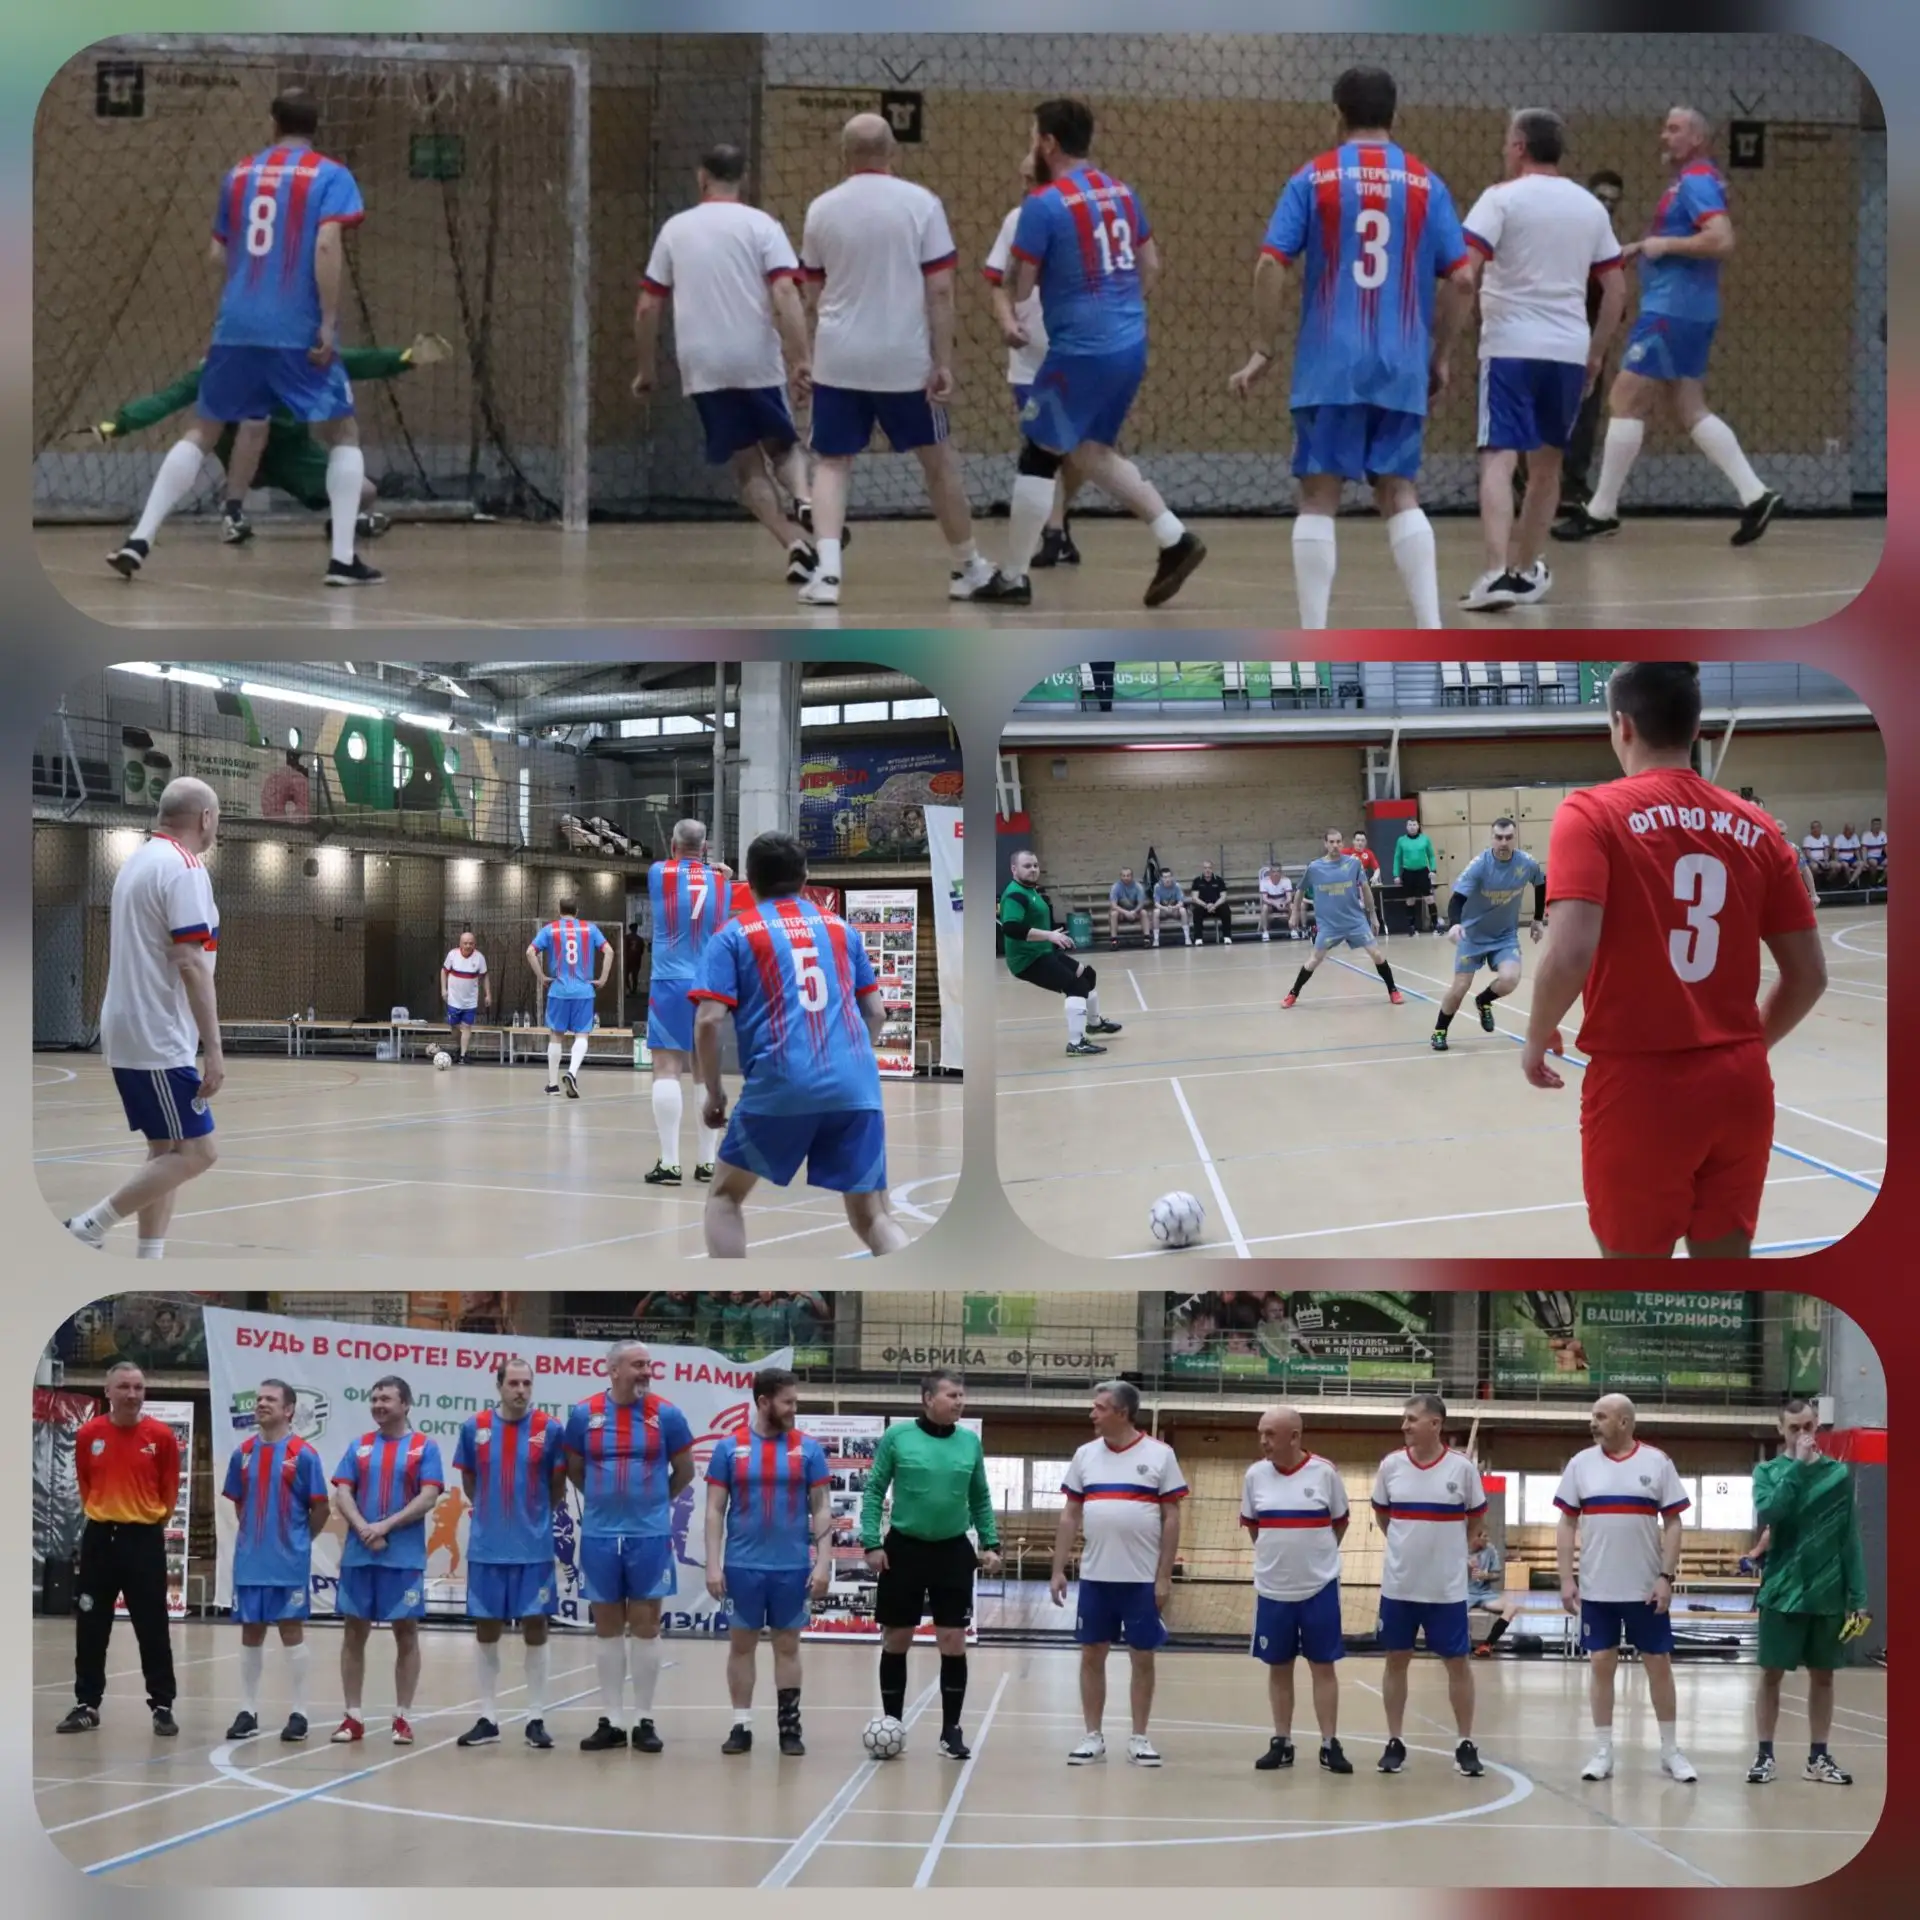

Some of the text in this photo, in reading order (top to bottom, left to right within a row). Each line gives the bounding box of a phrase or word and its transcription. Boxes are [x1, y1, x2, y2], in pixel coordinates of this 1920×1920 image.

[247, 195, 277, 256] 8
[1093, 218, 1135, 275] 13
[1353, 208, 1391, 289] 3
[1628, 804, 1765, 847] ФГП ВО ЖДТ
[687, 885, 709, 920] 7
[1669, 853, 1727, 983] 3
[566, 940, 578, 965] 8
[792, 946, 829, 1012] 5
[1587, 1308, 1743, 1329] ВАШИХ ТУРНИРОВ
[1635, 1291, 1743, 1311] ТЕРРИТОРИЯ
[236, 1327, 304, 1354] БУДЬ
[313, 1336, 329, 1355] В
[336, 1339, 448, 1367] СПОРТЕ!
[675, 1362, 757, 1389] НАМИ
[882, 1347, 1117, 1368] ФАБРИКА ФУТБОЛА
[436, 1394, 477, 1411] ФГП
